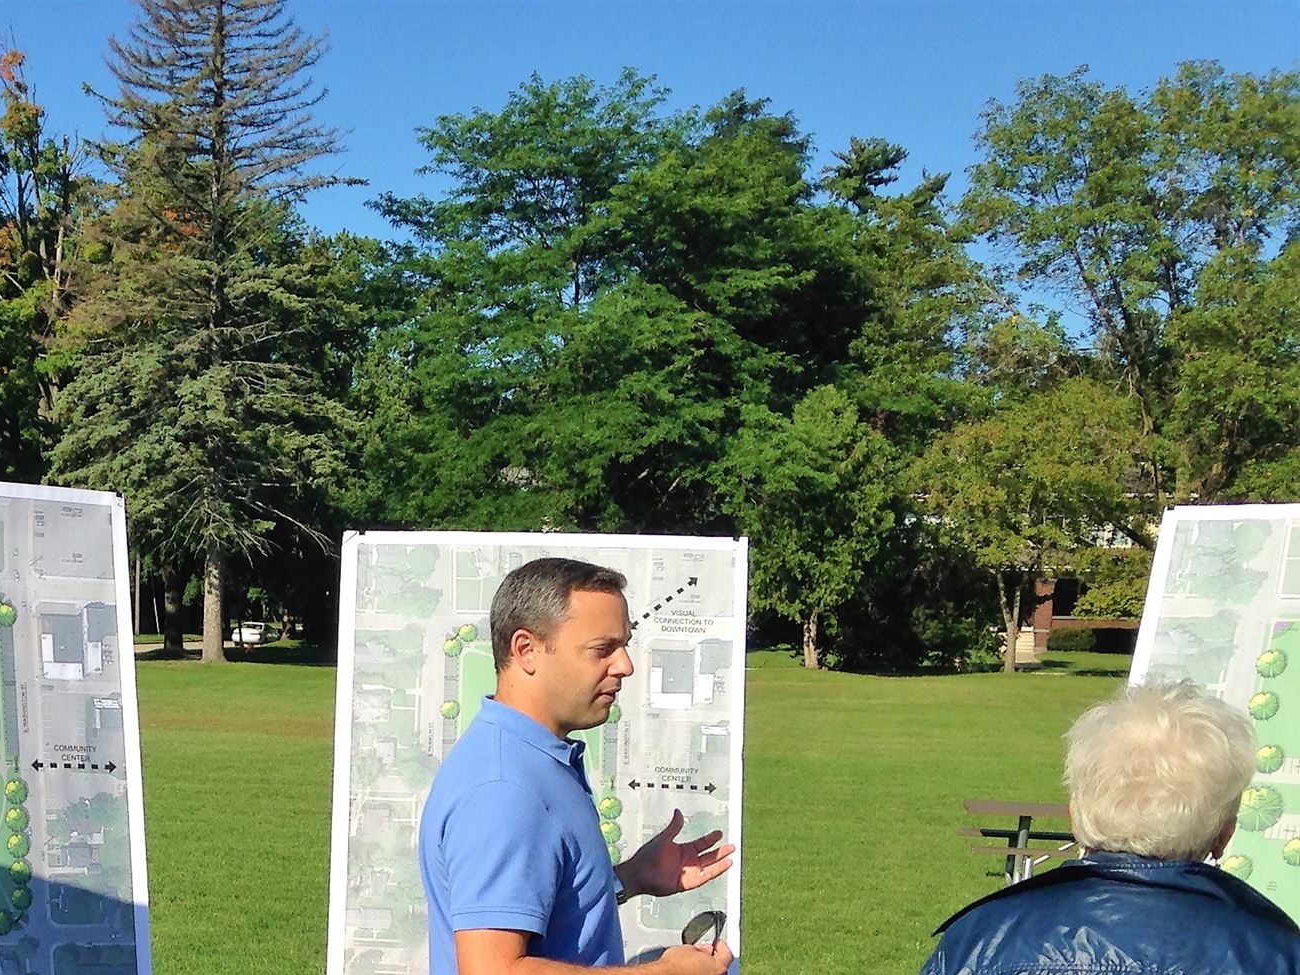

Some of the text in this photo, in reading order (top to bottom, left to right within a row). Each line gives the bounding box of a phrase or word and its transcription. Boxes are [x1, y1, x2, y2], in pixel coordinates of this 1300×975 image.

[653, 617, 702, 625] CONNECTION
[661, 625, 706, 633] DOWNTOWN
[53, 744, 97, 753] COMMUNITY
[61, 754, 90, 762] CENTER
[654, 766, 699, 774] COMMUNITY
[661, 775, 691, 783] CENTER
